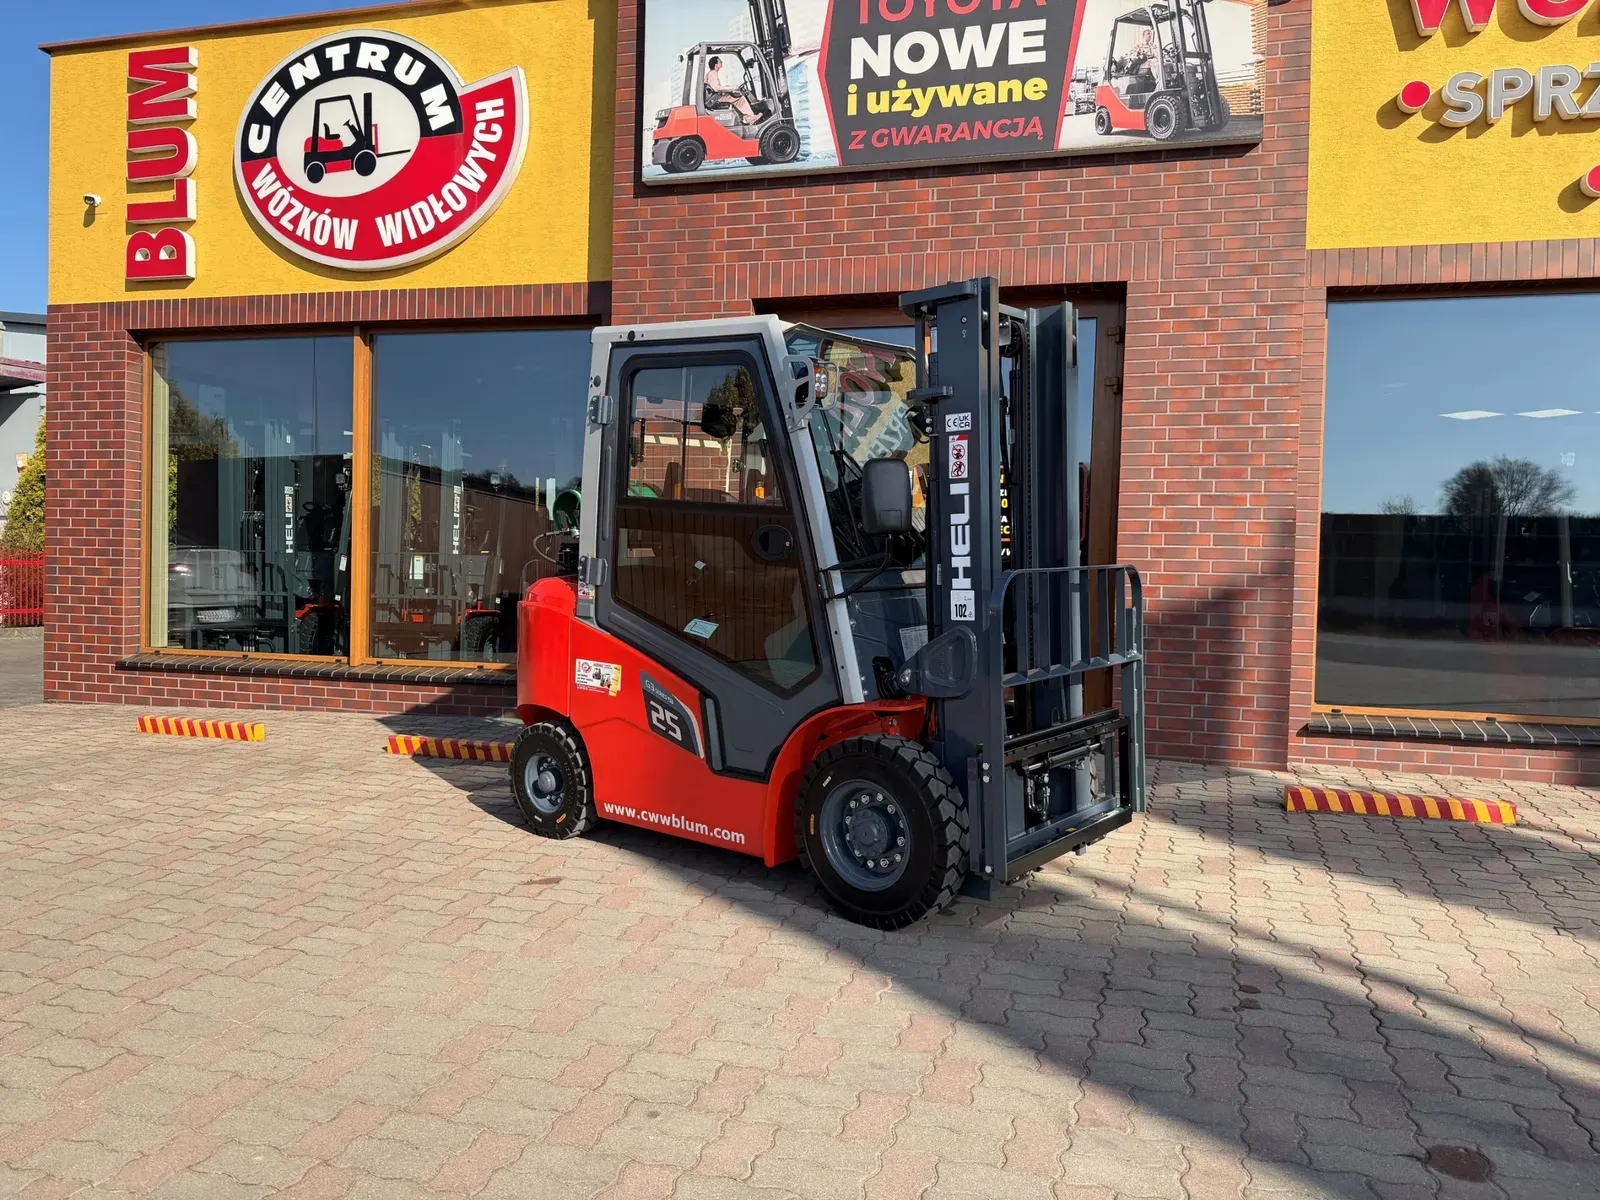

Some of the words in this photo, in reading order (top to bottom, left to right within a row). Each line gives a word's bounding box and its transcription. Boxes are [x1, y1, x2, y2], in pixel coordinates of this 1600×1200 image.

[850, 19, 1047, 79] NOWE
[248, 41, 456, 153] CENTRUM
[847, 83, 858, 116] i
[866, 77, 1048, 118] używane
[848, 130, 867, 150] Z
[871, 116, 1044, 148] GWARANCJĄ
[126, 46, 197, 279] BLUM
[251, 162, 359, 251] WÓZKÓW
[375, 97, 505, 247] WIDŁOWYCH
[285, 513, 294, 553] HELI
[452, 512, 460, 554] HELI
[950, 482, 972, 589] HELI
[954, 603, 967, 617] 102
[650, 700, 682, 741] 25
[603, 802, 746, 845] www.cwwblum.com
